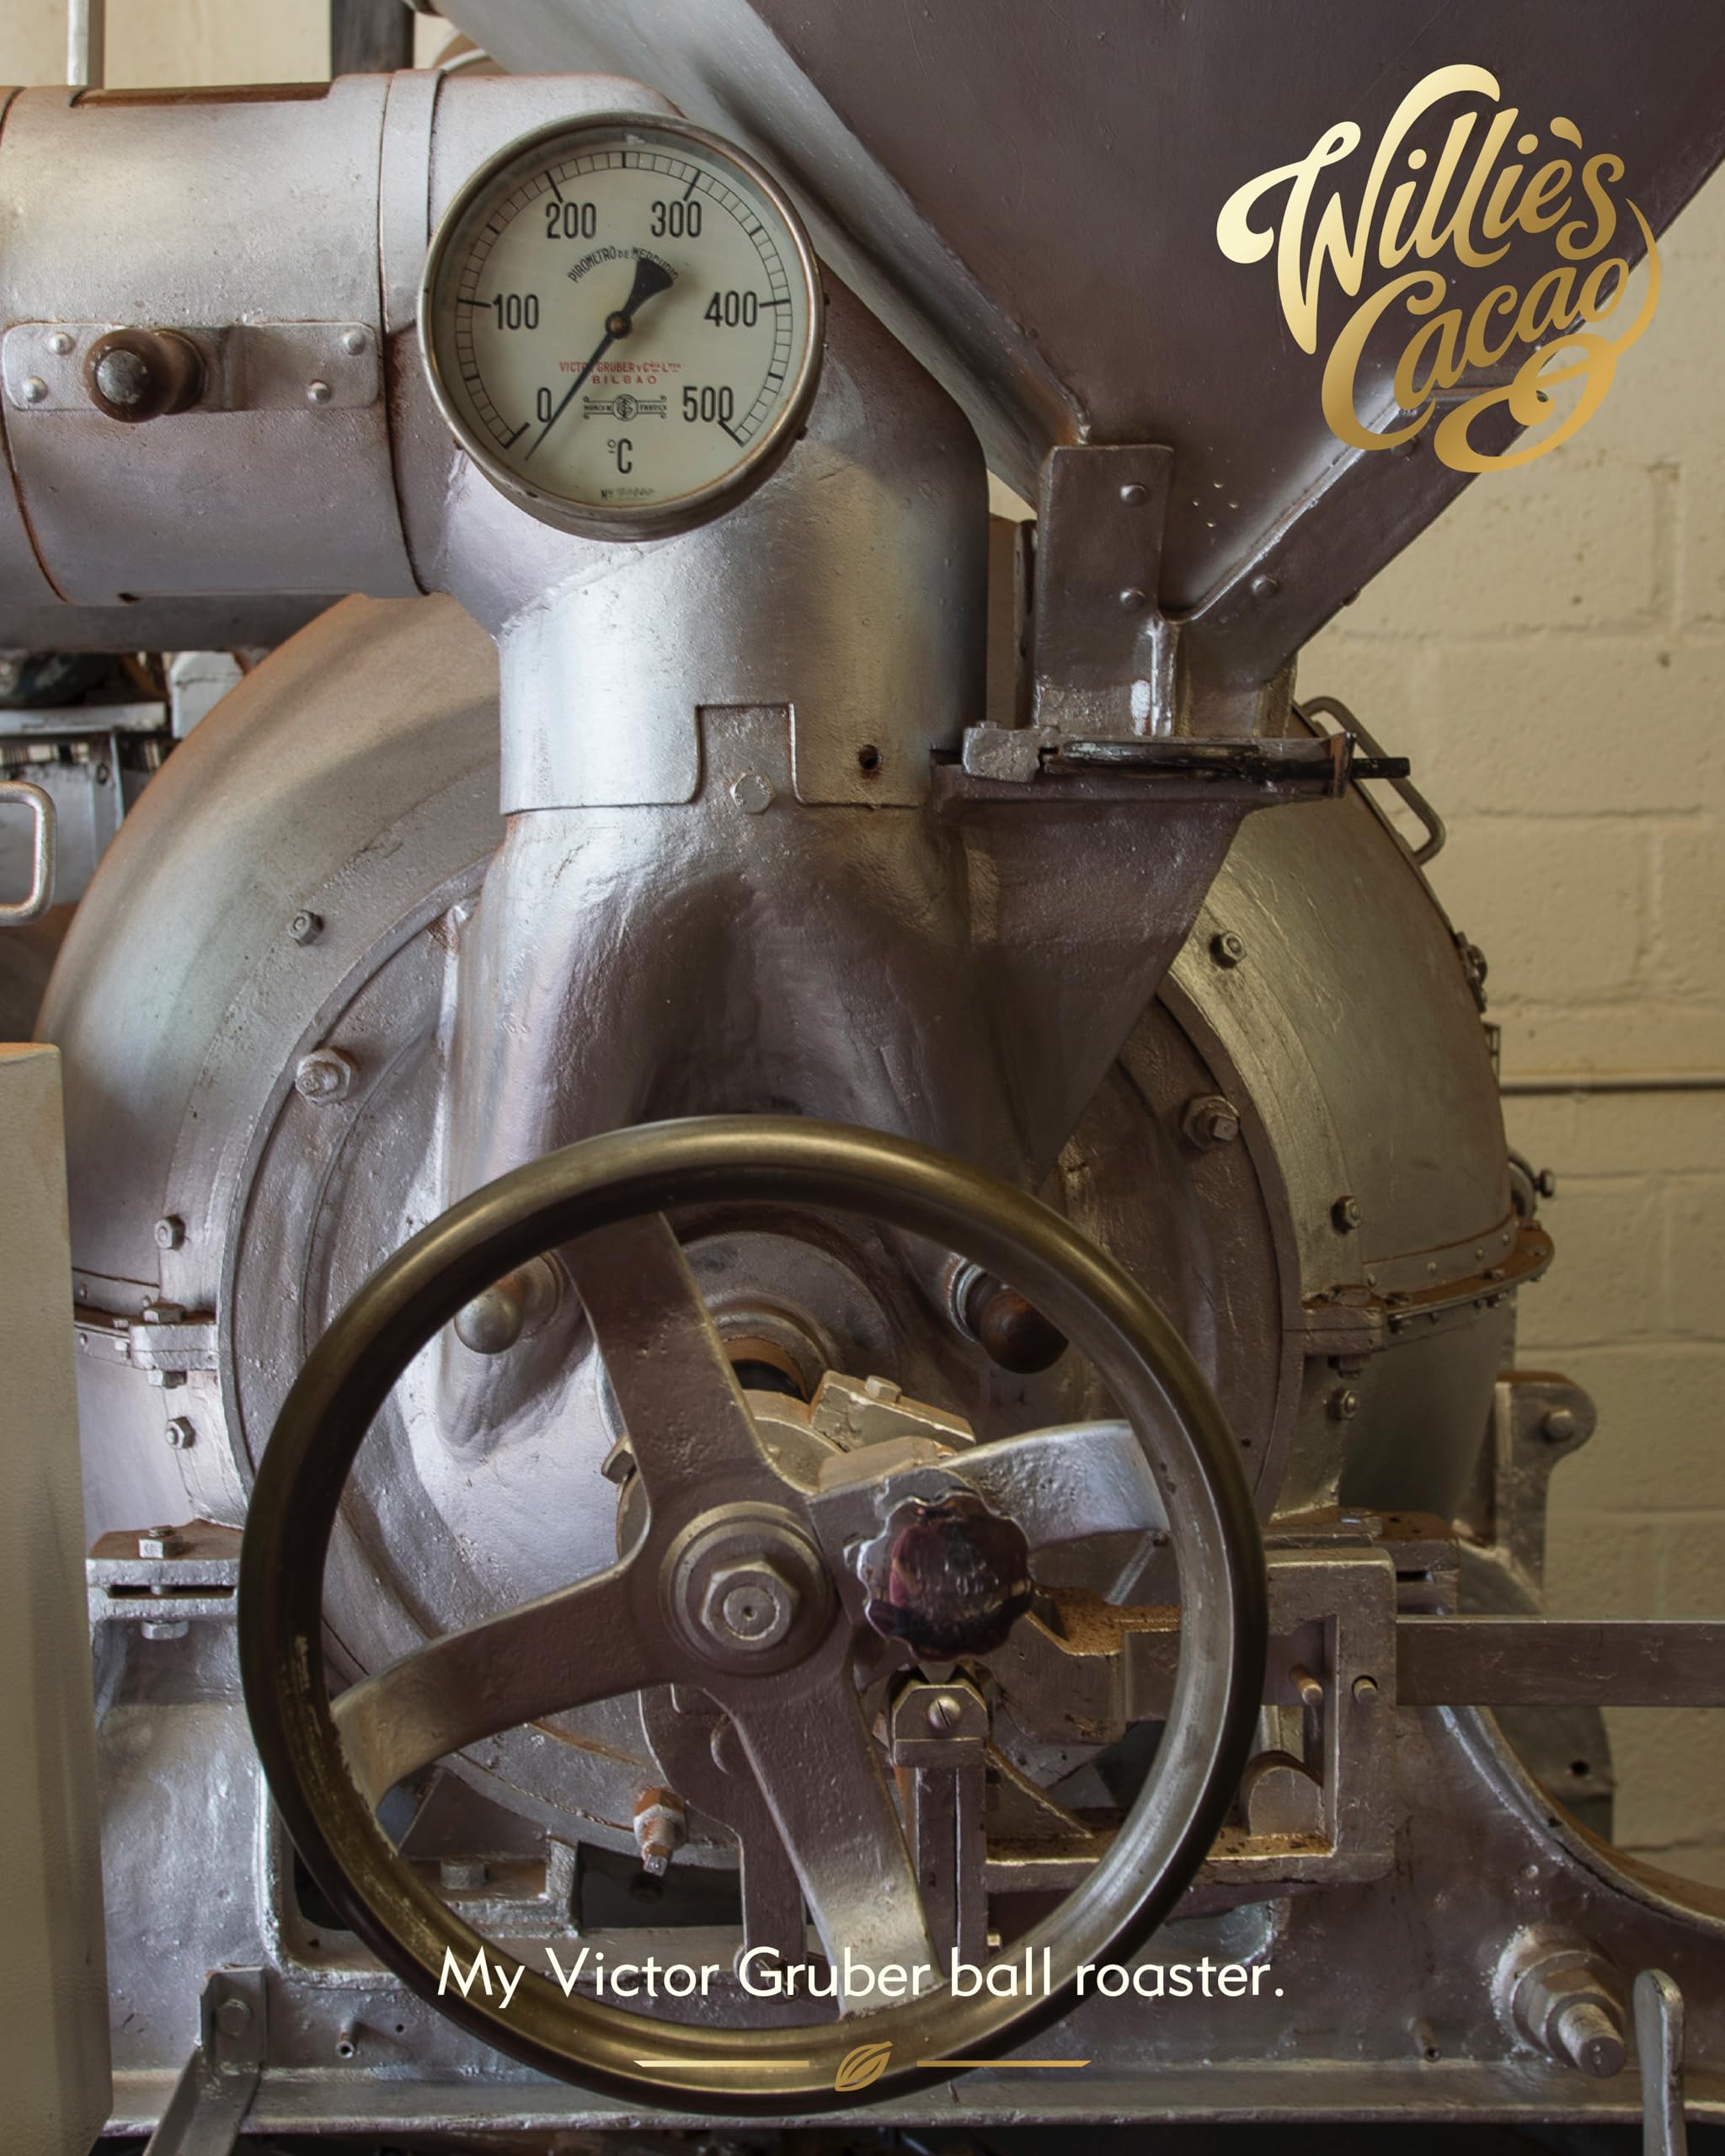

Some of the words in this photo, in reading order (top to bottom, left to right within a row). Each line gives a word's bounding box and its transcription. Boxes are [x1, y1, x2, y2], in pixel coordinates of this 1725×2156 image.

[546, 201, 596, 239] 200
[651, 200, 702, 238] 300
[493, 294, 539, 330] 100
[704, 291, 758, 328] 400
[559, 361, 595, 372] VICT
[597, 362, 634, 372] GRUBER
[592, 376, 657, 385] BILBAO
[537, 387, 553, 422] 0
[683, 386, 734, 422] 500
